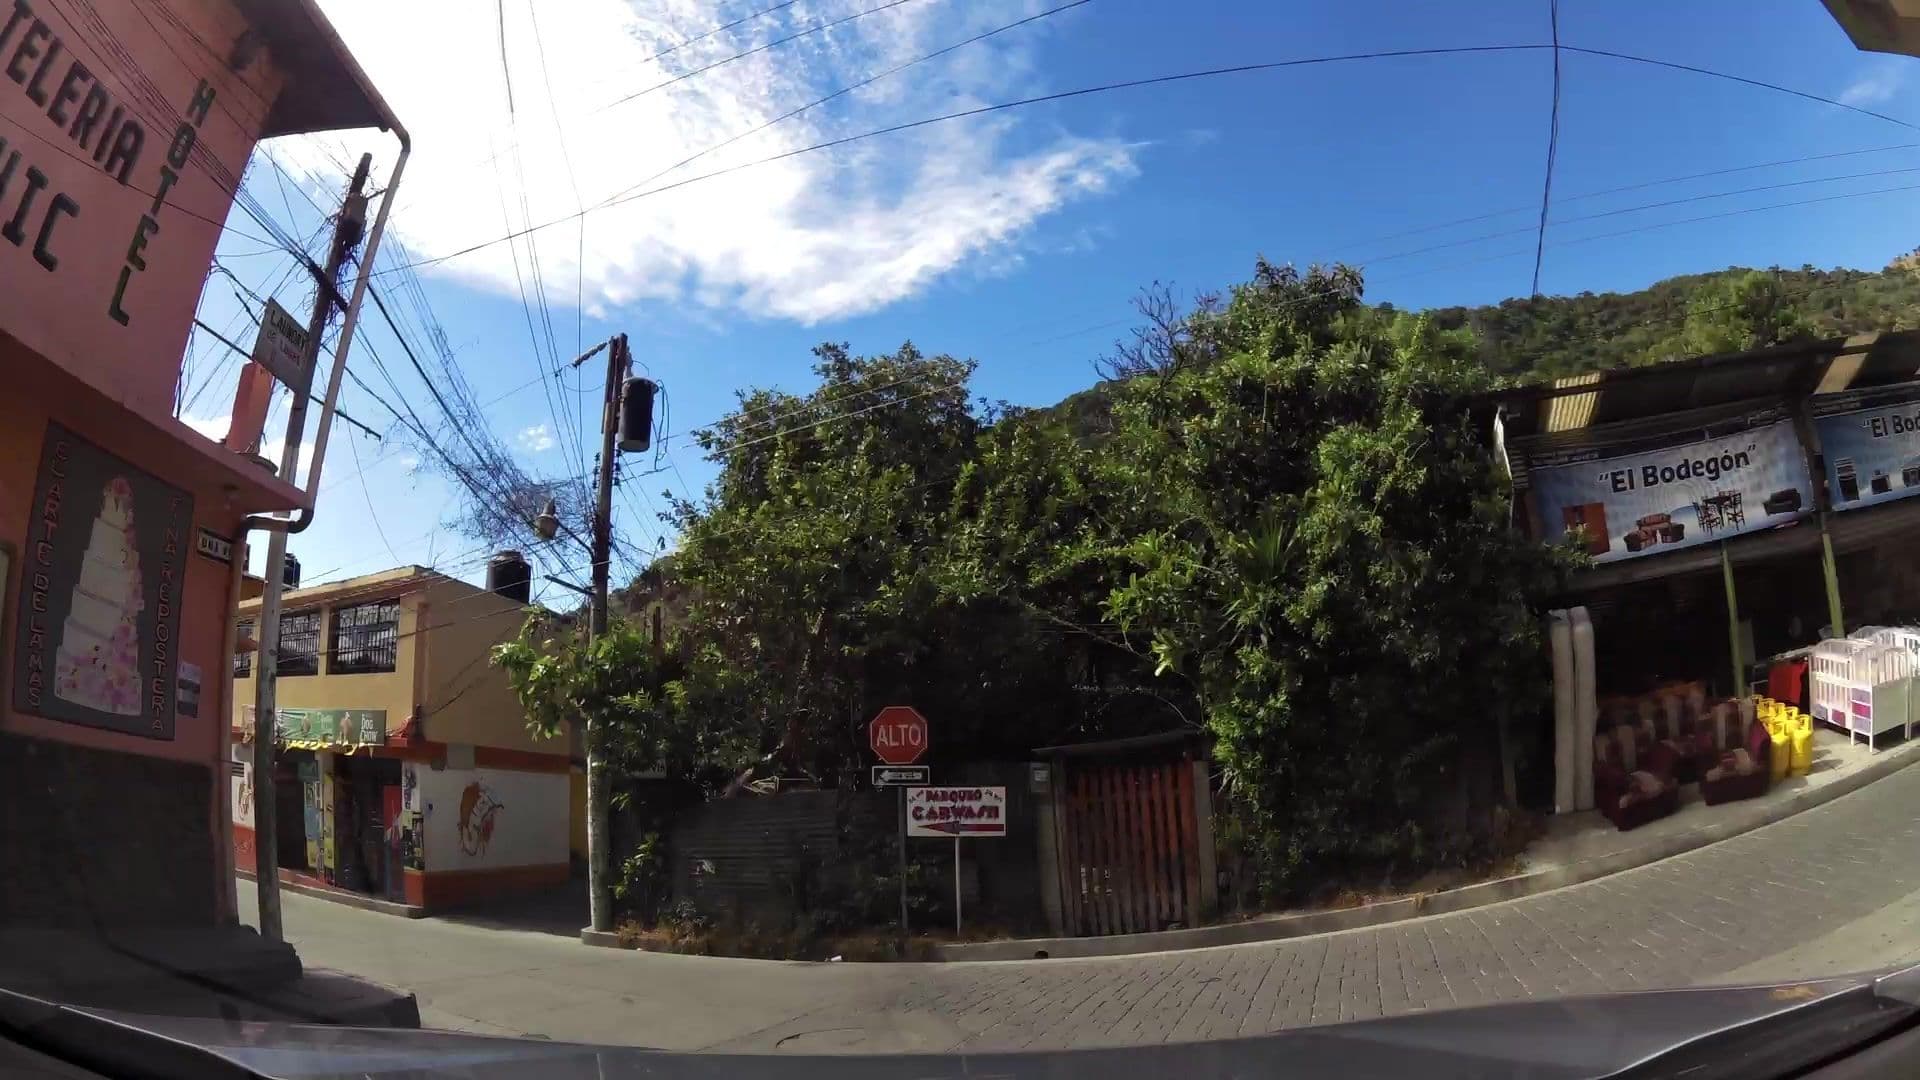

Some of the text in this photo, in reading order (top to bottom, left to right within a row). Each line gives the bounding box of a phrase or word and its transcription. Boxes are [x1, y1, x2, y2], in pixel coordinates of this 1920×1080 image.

[108, 78, 216, 327] HOTEL
[1599, 443, 1756, 493] "El Bodegón"
[877, 724, 922, 747] ALTO
[925, 789, 983, 802] PARQUEO
[912, 805, 1000, 821] CARWASH
